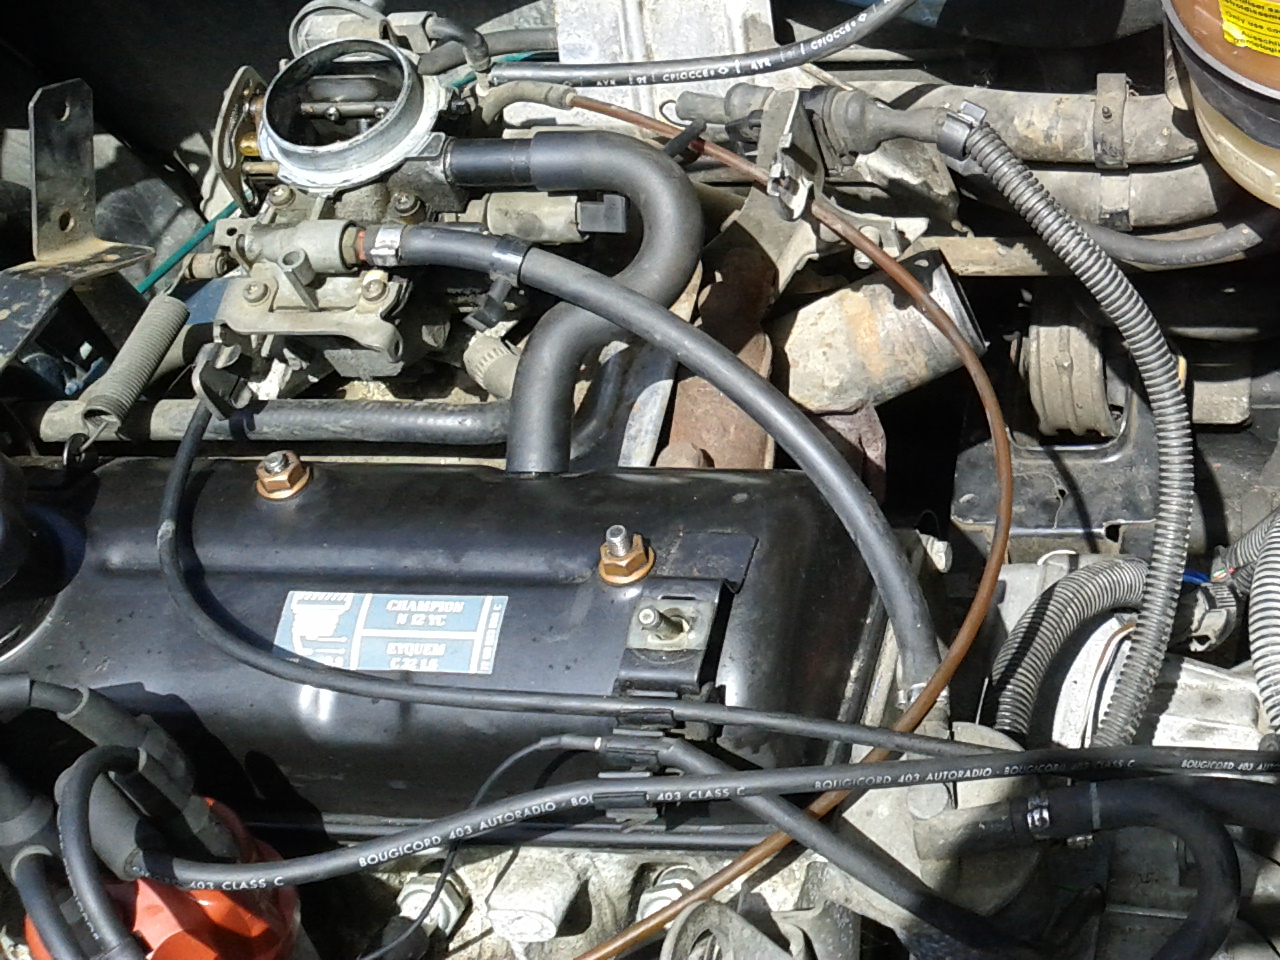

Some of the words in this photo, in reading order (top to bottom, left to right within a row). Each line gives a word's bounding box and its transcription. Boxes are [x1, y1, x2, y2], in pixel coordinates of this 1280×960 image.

[1225, 11, 1246, 26] Only
[1248, 19, 1265, 29] use
[385, 599, 464, 613] CHAMPION
[1181, 758, 1236, 773] BOUGICORD
[1237, 761, 1255, 773] 403
[814, 773, 891, 790] BOUGICORD
[897, 773, 920, 782] 403
[925, 767, 992, 781] AUTORADIO
[657, 790, 681, 801] 403
[688, 787, 730, 800] CLASS
[736, 786, 745, 795] C
[478, 801, 556, 830] AUTORADIO
[358, 835, 442, 867] BOUGICORD
[447, 824, 473, 839] 403
[222, 877, 265, 890] CLASS
[273, 875, 284, 886] C
